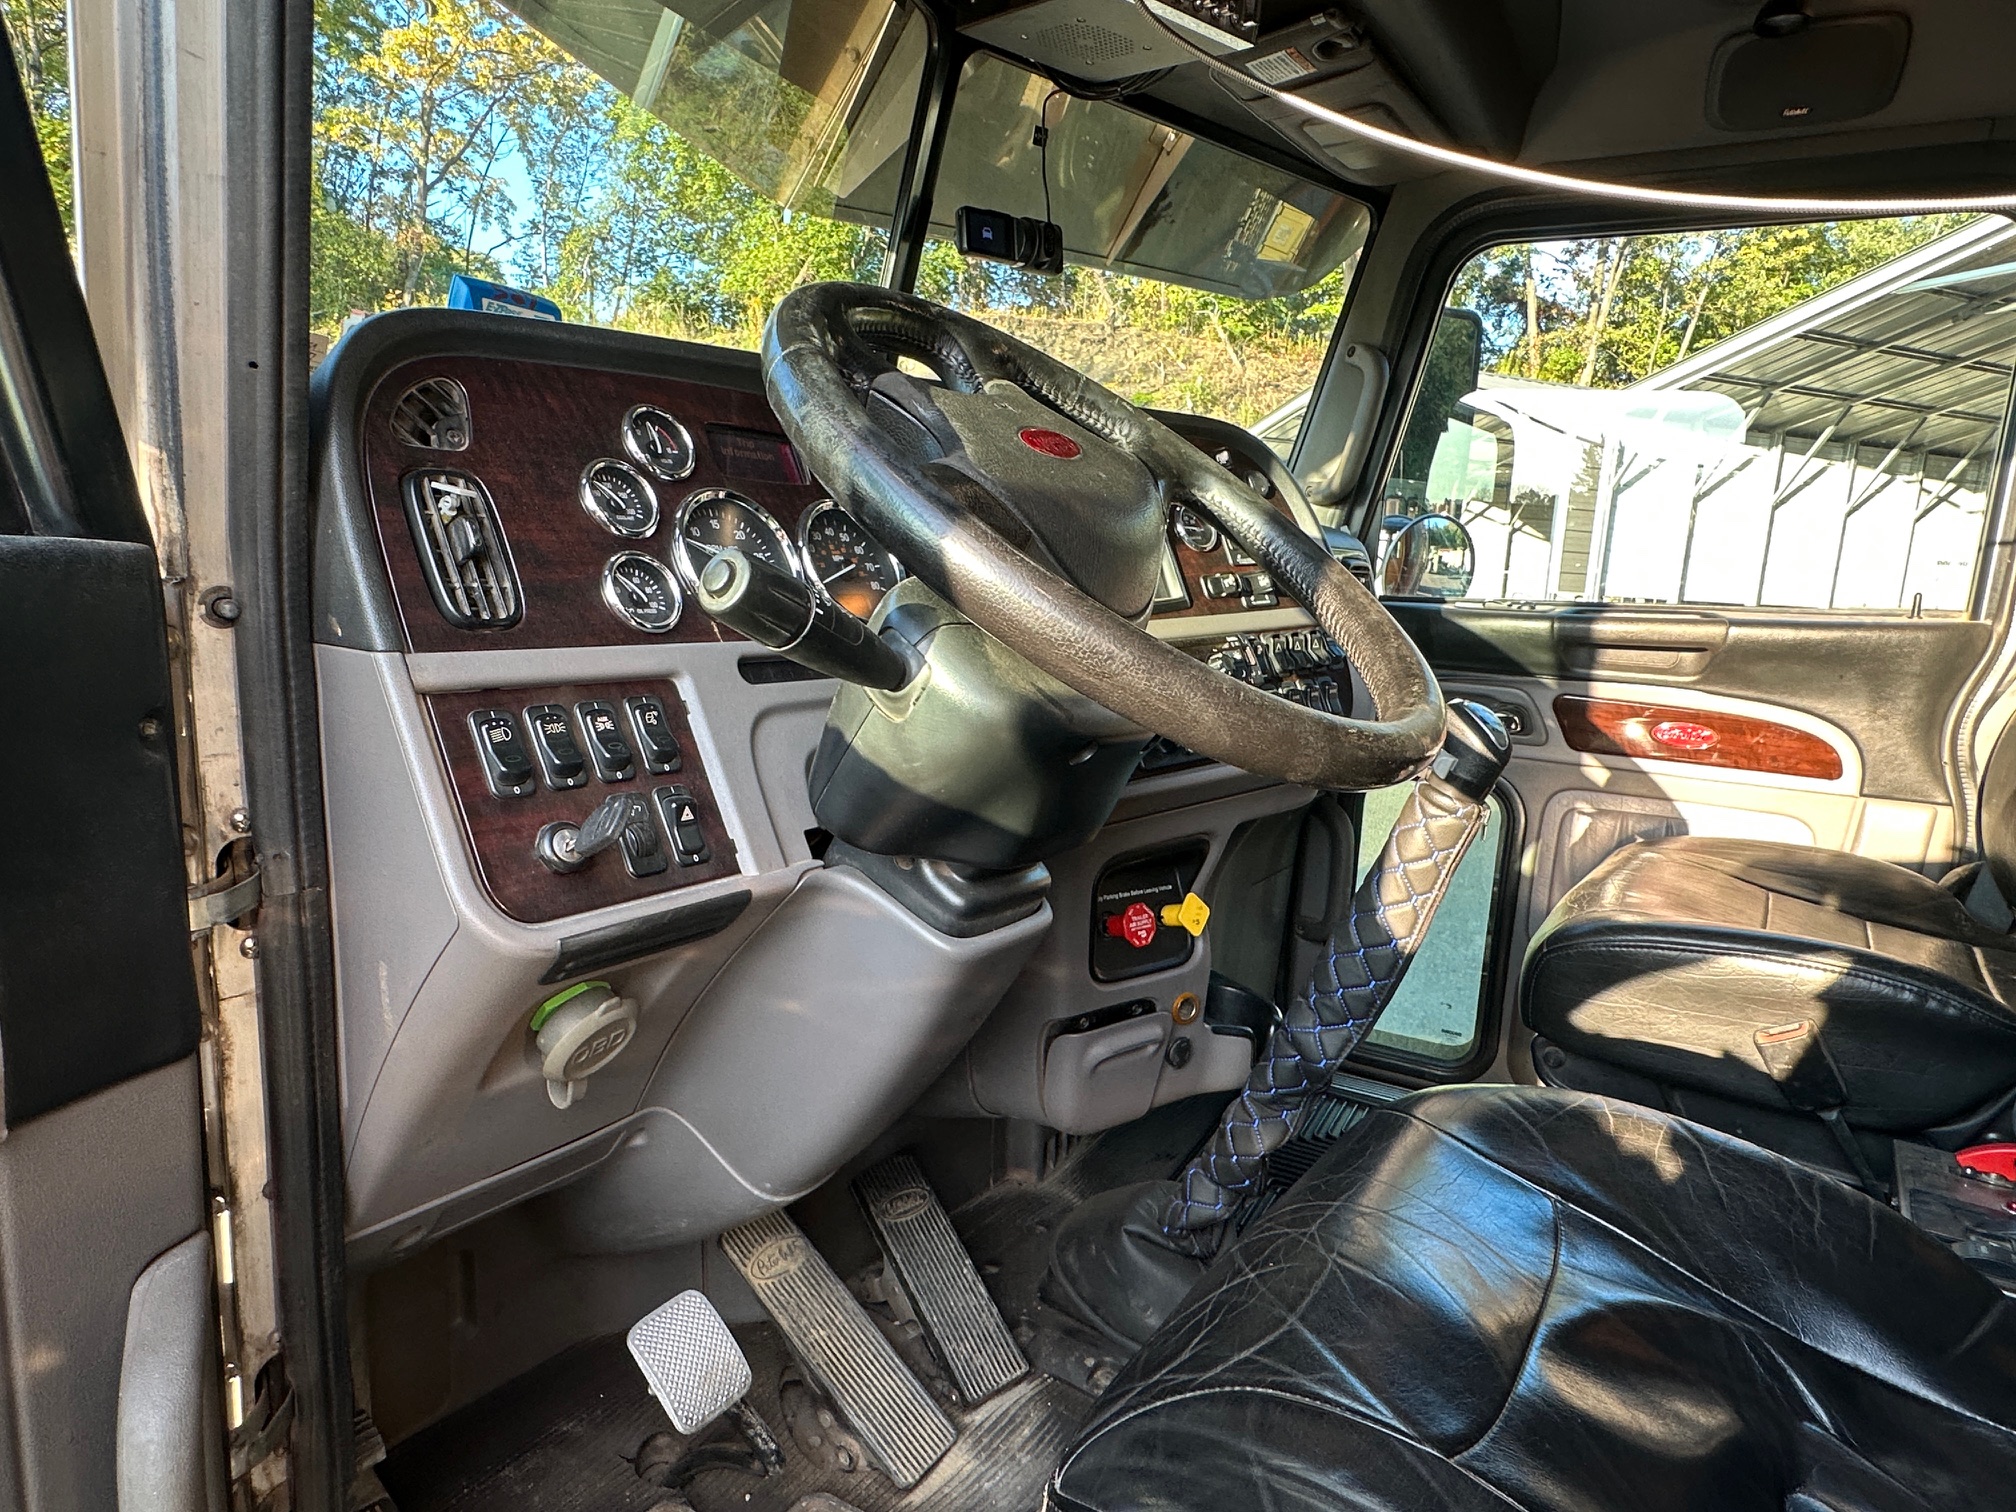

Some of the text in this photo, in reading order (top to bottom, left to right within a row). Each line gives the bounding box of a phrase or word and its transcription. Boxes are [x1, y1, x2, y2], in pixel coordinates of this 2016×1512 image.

[709, 519, 720, 529] 15
[690, 527, 700, 537] 10
[734, 530, 746, 540] 20
[825, 527, 835, 536] 40
[839, 532, 850, 542] 50
[854, 545, 864, 555] 60
[865, 562, 875, 572] 70
[870, 581, 880, 590] 80
[571, 1028, 626, 1065] OBD
